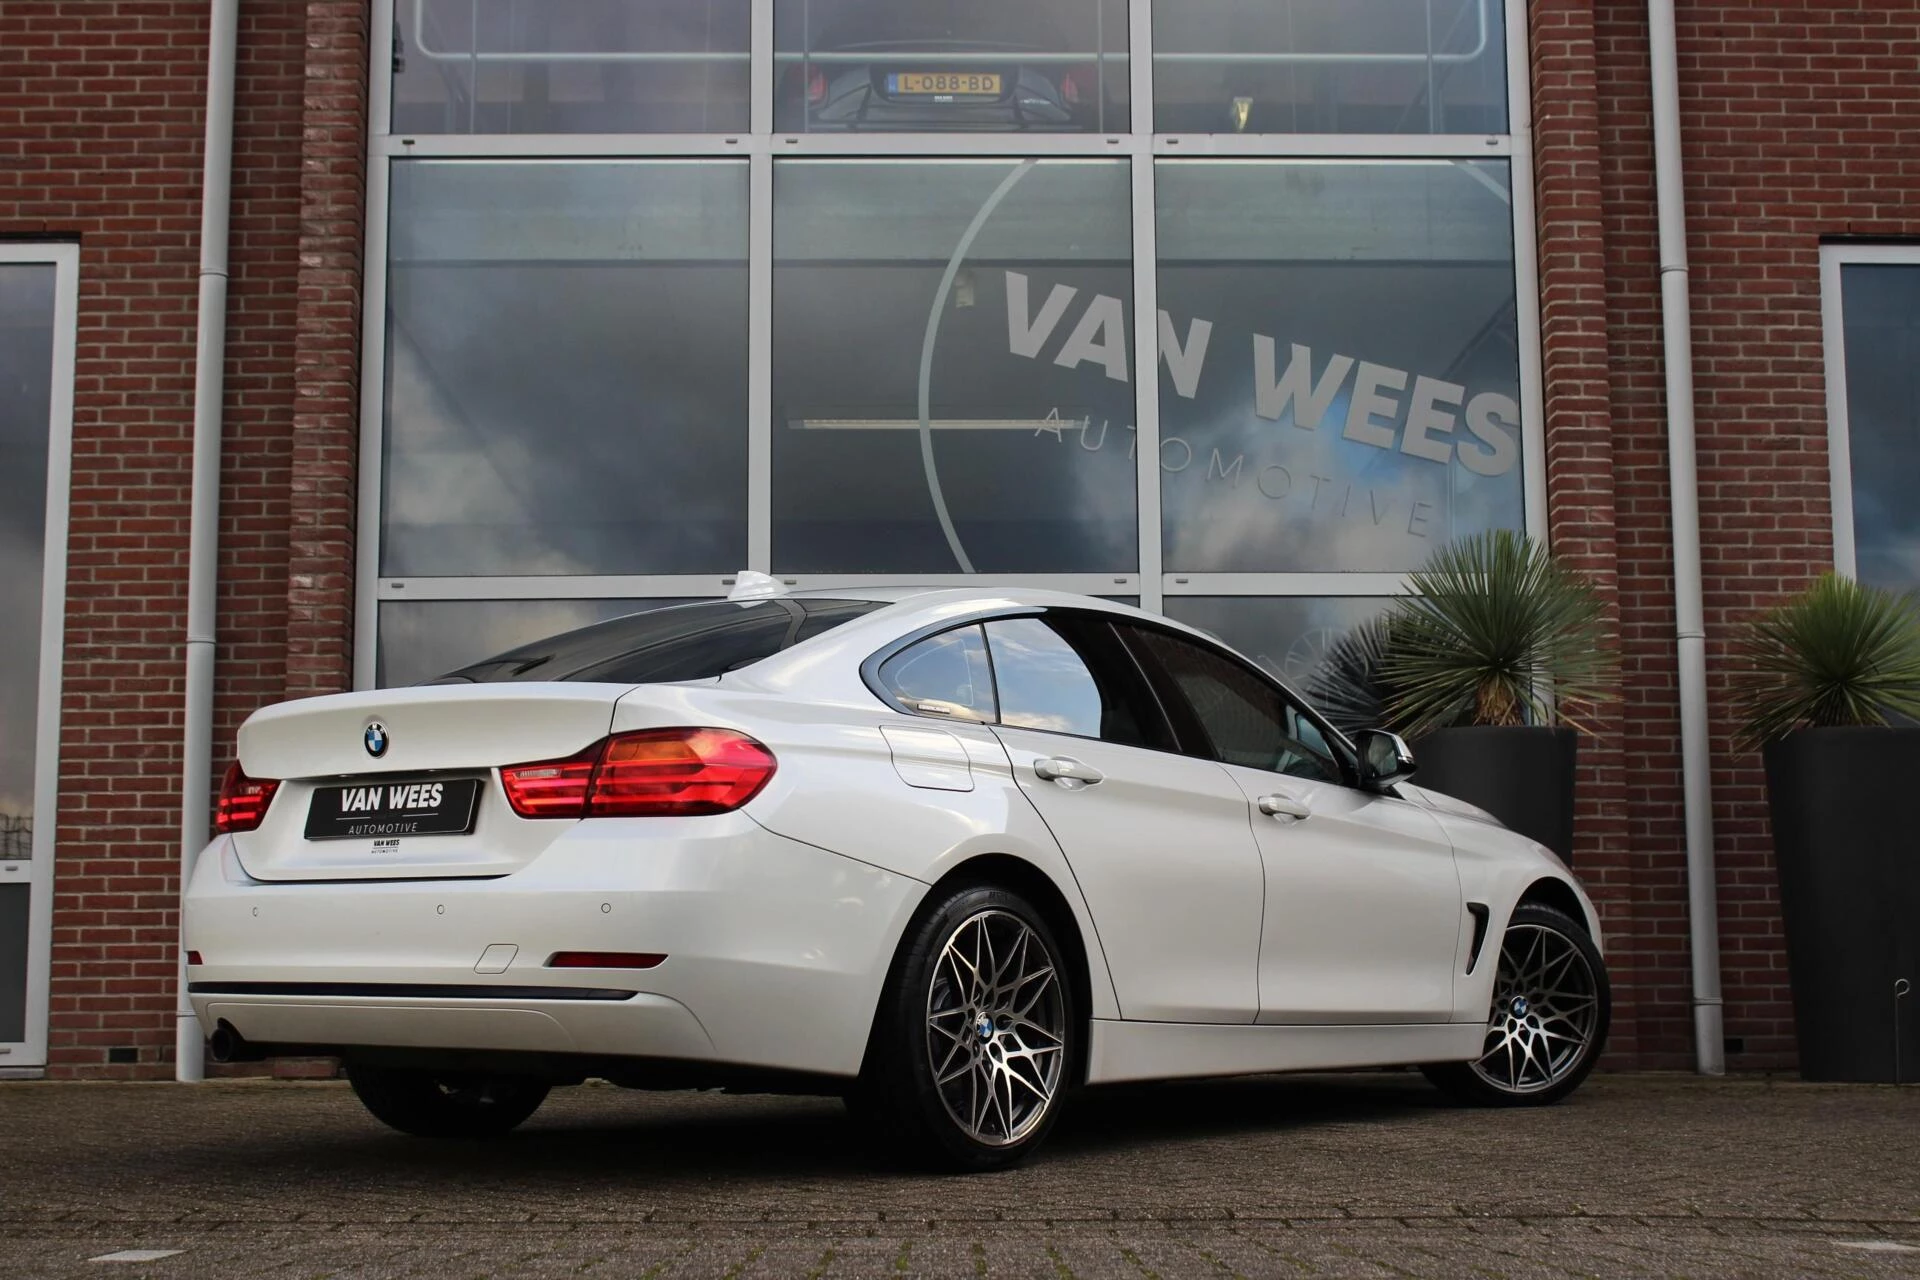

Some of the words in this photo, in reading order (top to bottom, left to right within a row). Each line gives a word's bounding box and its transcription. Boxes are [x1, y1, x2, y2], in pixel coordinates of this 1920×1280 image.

[904, 75, 994, 91] L-088-BD
[1005, 270, 1213, 399] VAN
[1252, 333, 1519, 477] WEES
[341, 787, 383, 812] VAN
[388, 783, 444, 810] WEES
[348, 822, 418, 834] AUTOMOTIVE
